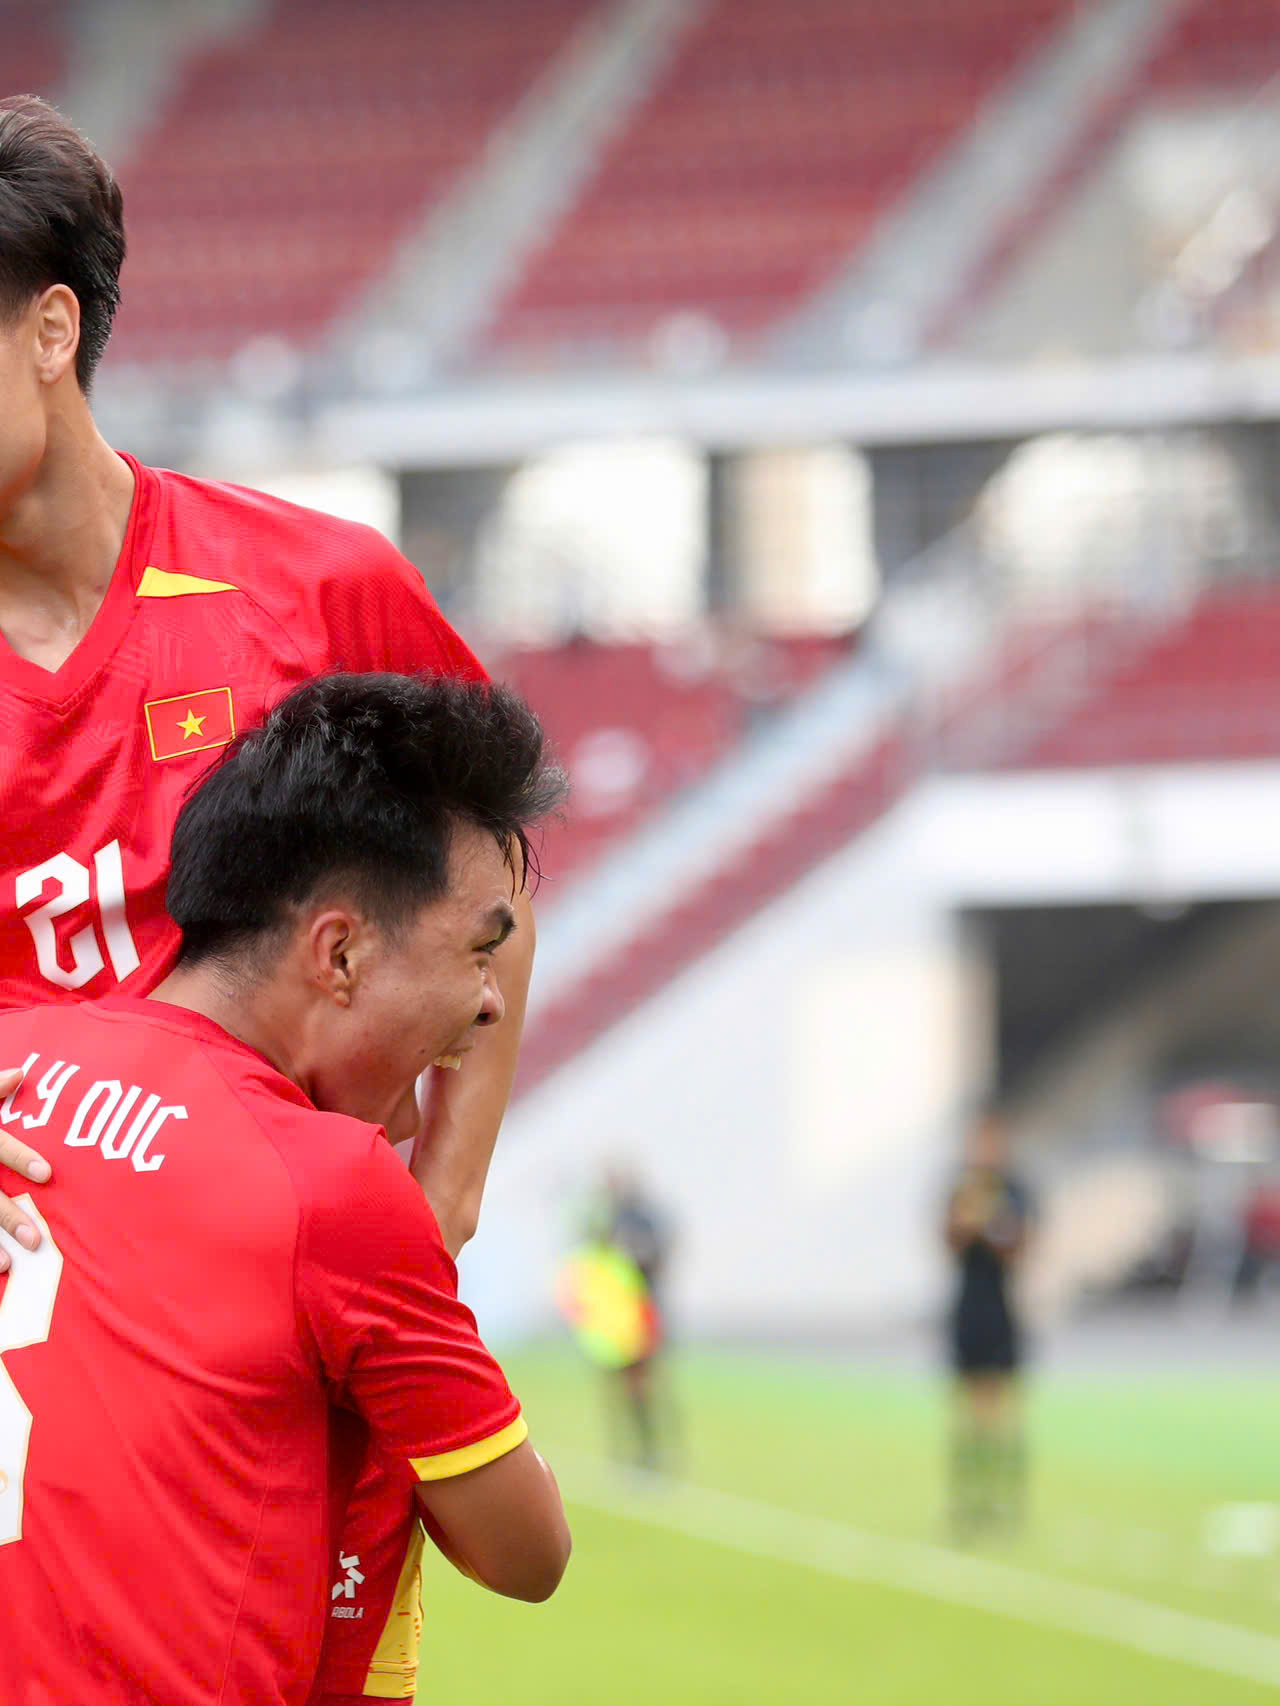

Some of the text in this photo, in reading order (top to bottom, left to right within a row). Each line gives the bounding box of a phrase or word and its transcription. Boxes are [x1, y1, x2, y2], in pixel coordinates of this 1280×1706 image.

[15, 839, 141, 991] 21
[0, 1052, 81, 1130] LY
[63, 1079, 189, 1173] DUC
